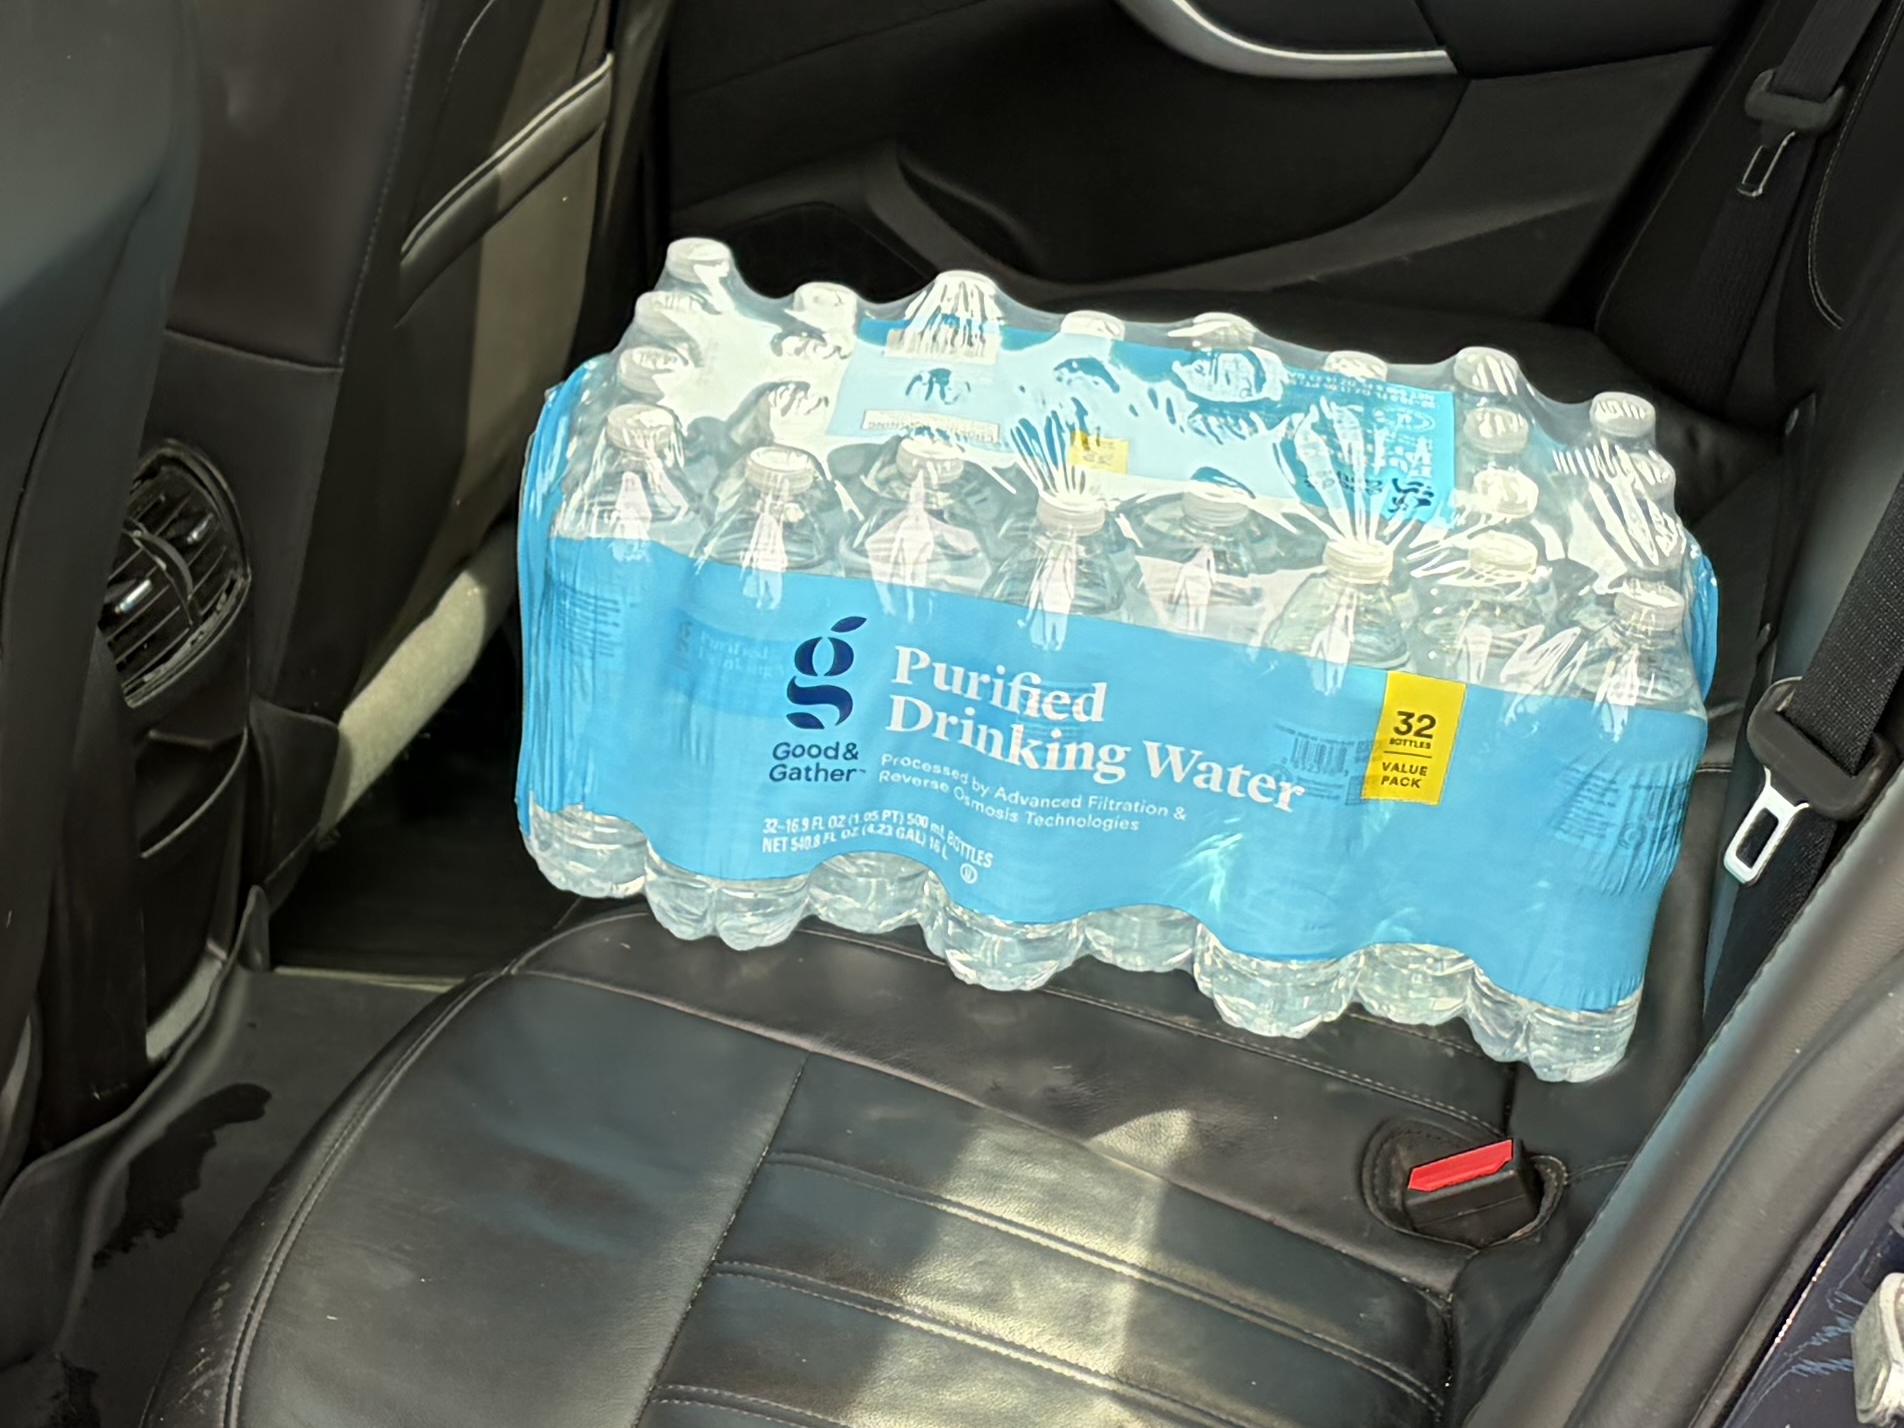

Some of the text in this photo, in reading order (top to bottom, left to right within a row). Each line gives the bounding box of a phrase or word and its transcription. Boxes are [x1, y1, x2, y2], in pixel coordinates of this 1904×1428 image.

[891, 645, 1107, 722] Purified
[1389, 737, 1431, 750] BOTTLES
[1393, 710, 1437, 739] 32
[885, 694, 1131, 785] Drinking
[1142, 740, 1306, 813] Water
[1381, 761, 1428, 777] VALUE
[878, 770, 1140, 832] Reverse Osmosis Technologies
[881, 753, 1187, 821] Processed by Advanced Filtration &
[1381, 775, 1421, 789] PACK
[762, 836, 788, 853] NET
[822, 831, 837, 844] FL
[840, 828, 859, 839] OZ
[929, 835, 941, 854] 16
[812, 816, 824, 831] FL
[828, 814, 845, 829] OZ
[906, 812, 929, 829] 500
[946, 830, 994, 869] BOTTLES
